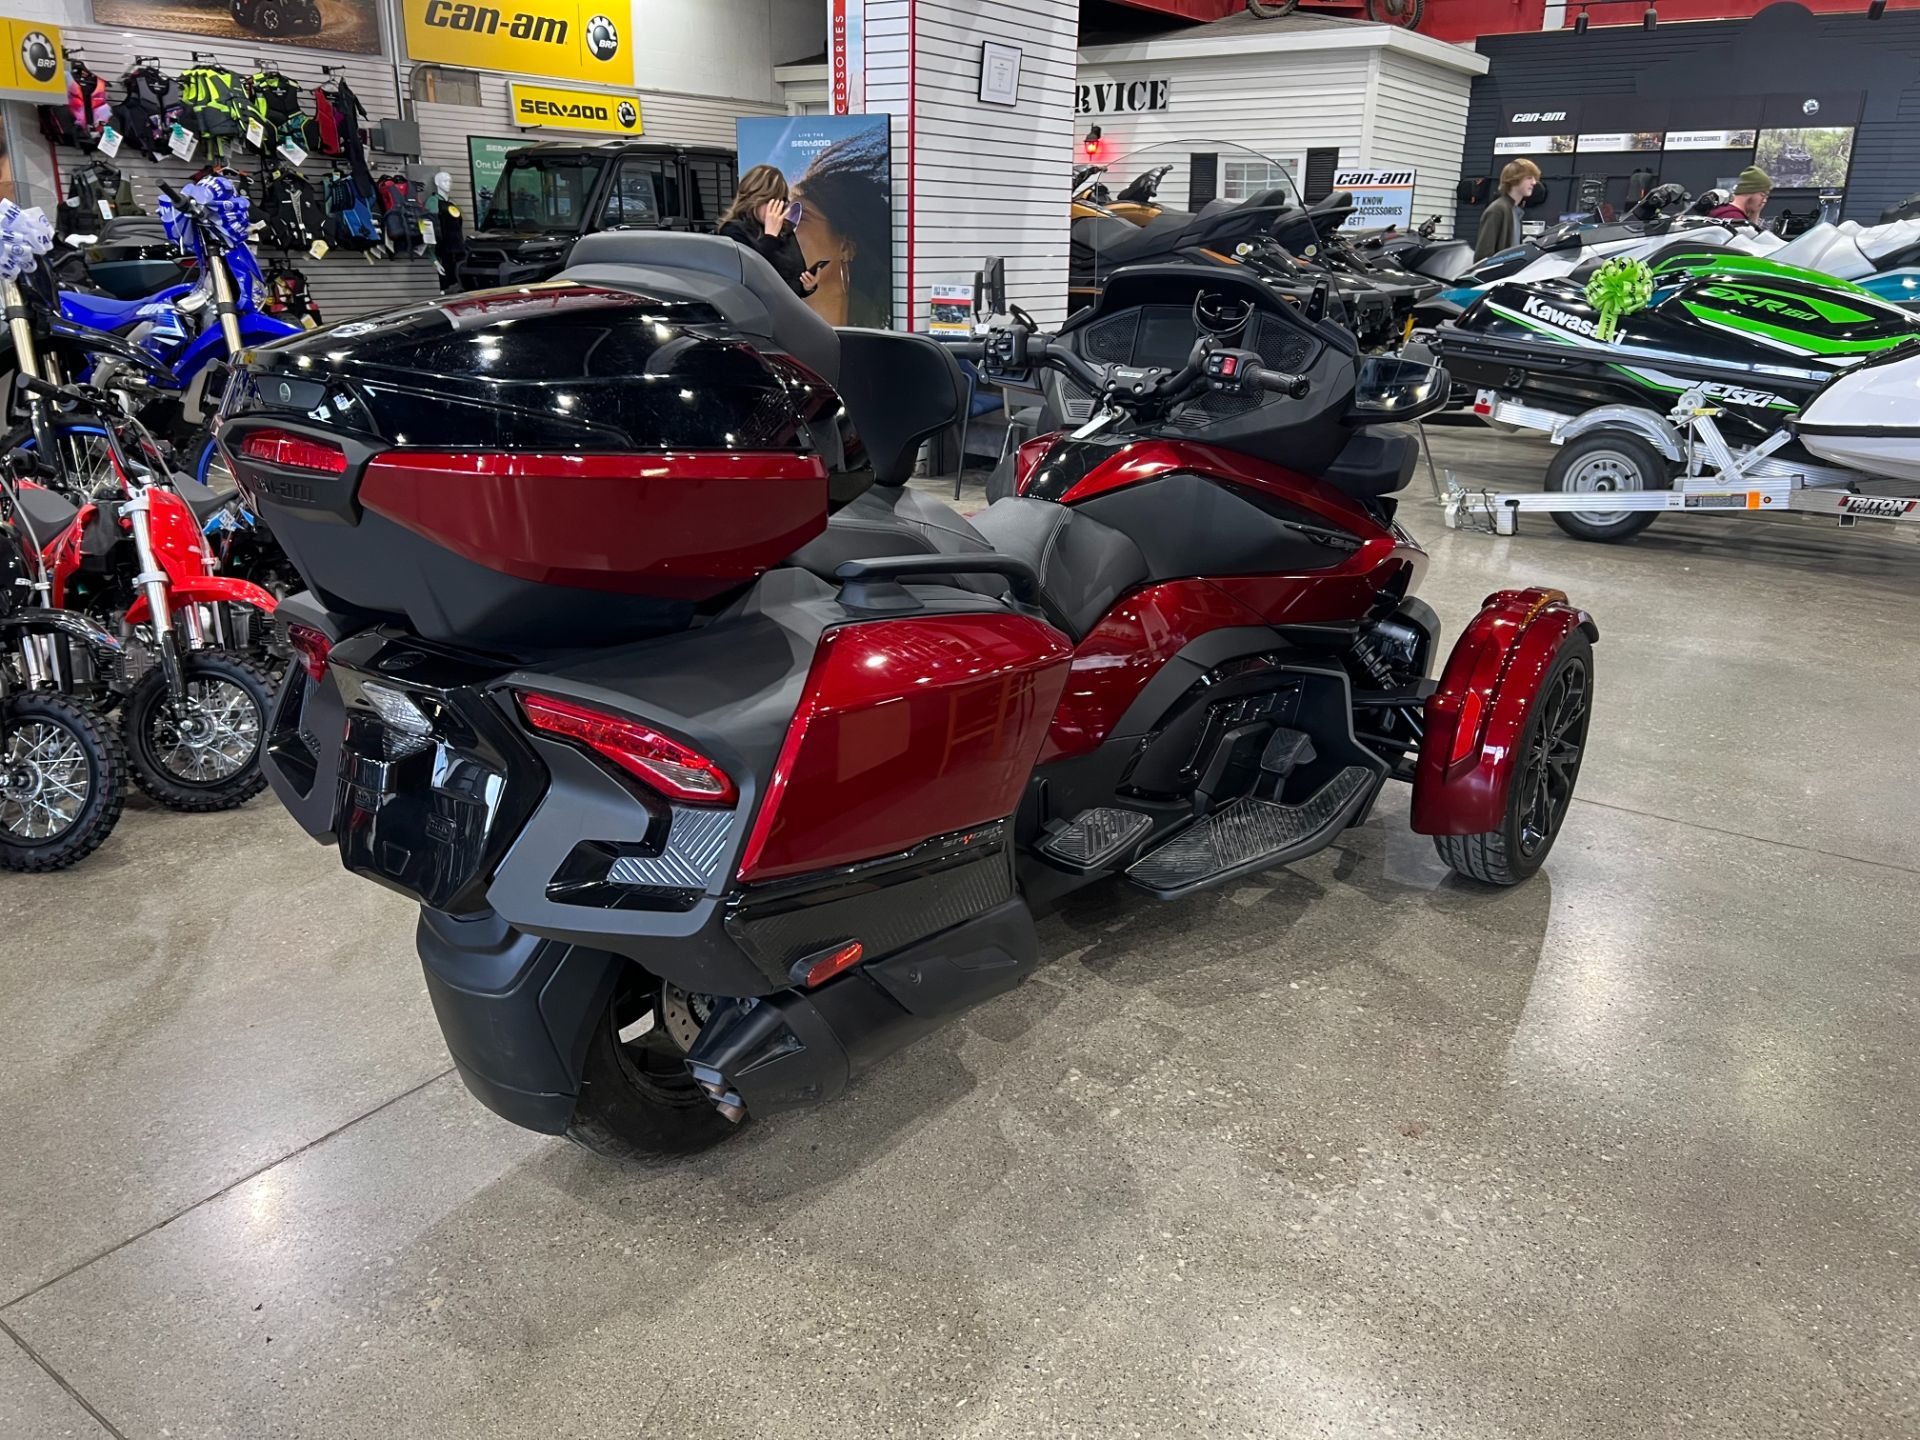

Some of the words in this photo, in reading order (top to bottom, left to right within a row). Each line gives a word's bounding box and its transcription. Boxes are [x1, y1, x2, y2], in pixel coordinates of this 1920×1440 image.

[425, 0, 568, 45] can-am
[598, 39, 617, 49] BRP
[37, 58, 56, 68] BRP
[1511, 112, 1567, 122] can-am
[1335, 172, 1412, 185] can-am
[1361, 196, 1384, 206] KNOW
[1359, 206, 1403, 216] ACCESSORIES
[1348, 217, 1366, 226] GET?
[1779, 308, 1820, 321] 160
[1522, 295, 1628, 346] Kawasai
[1845, 496, 1910, 512] TRITON
[1855, 508, 1897, 517] TRAILERS
